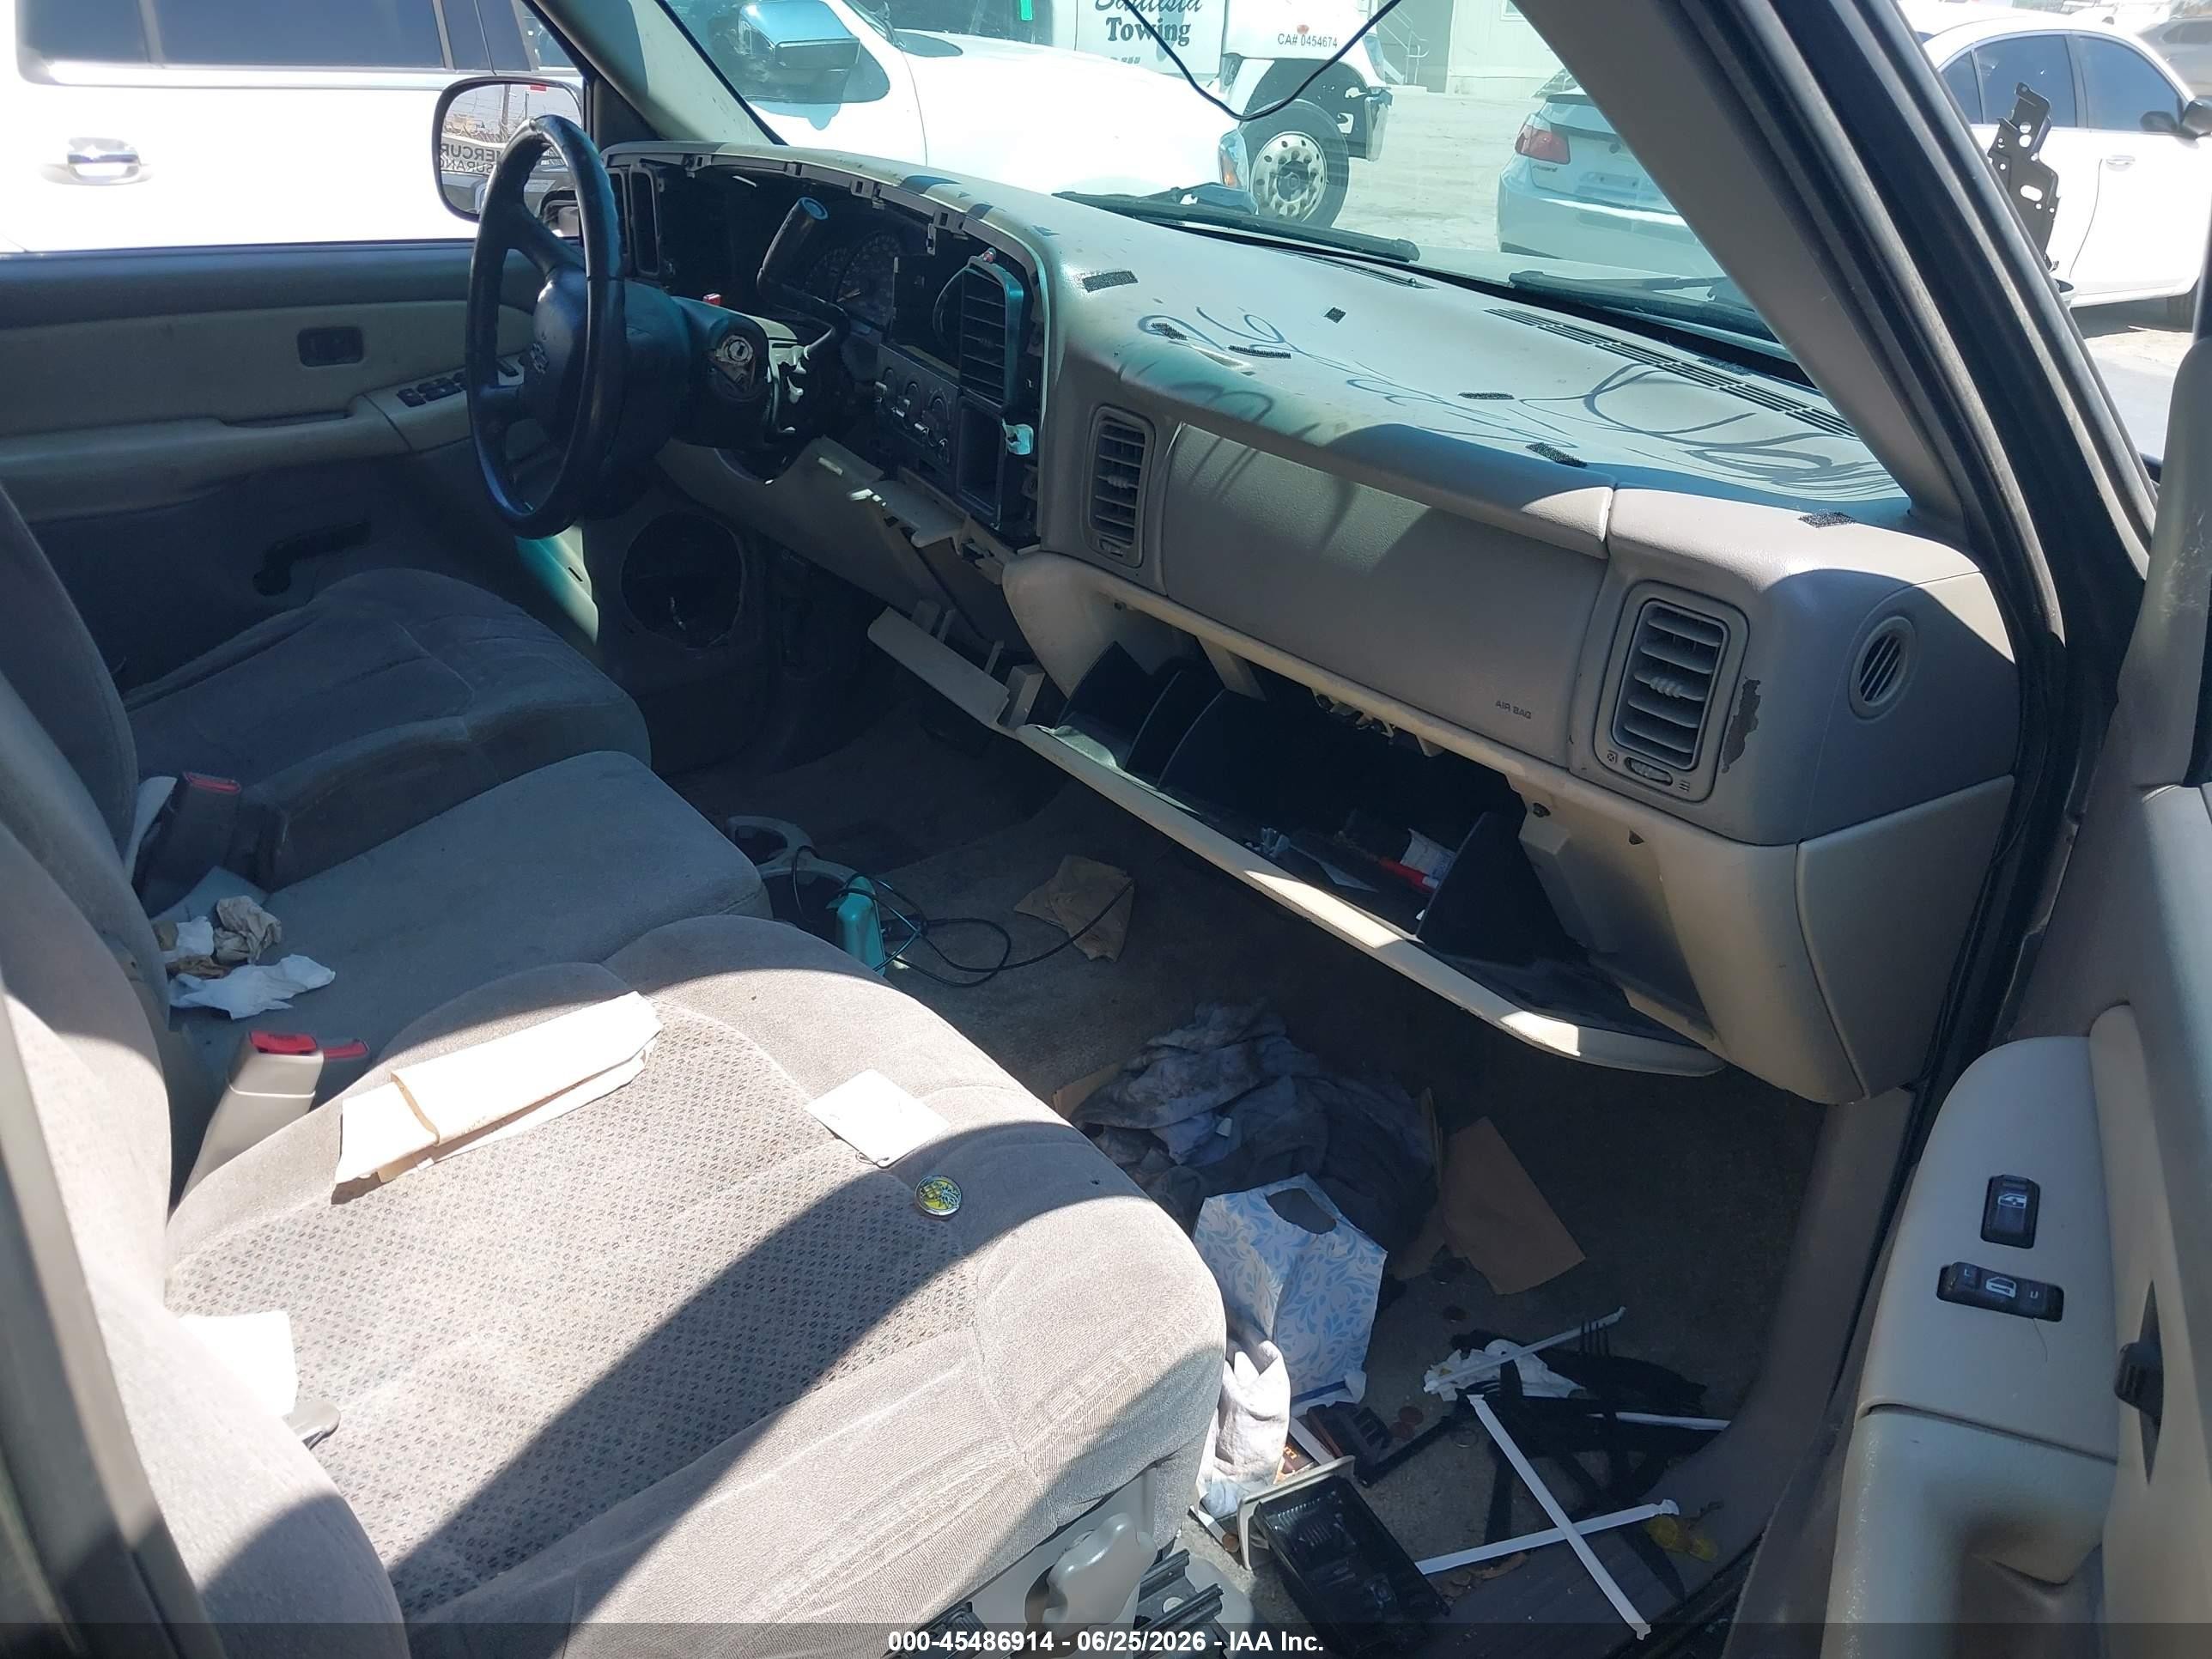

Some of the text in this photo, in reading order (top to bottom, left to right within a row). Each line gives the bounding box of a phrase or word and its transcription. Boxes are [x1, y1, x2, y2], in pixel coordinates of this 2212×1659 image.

[1106, 17, 1191, 46] Towing
[1278, 33, 1337, 48] CA# 0454674
[1495, 701, 1532, 720] AIR BAG
